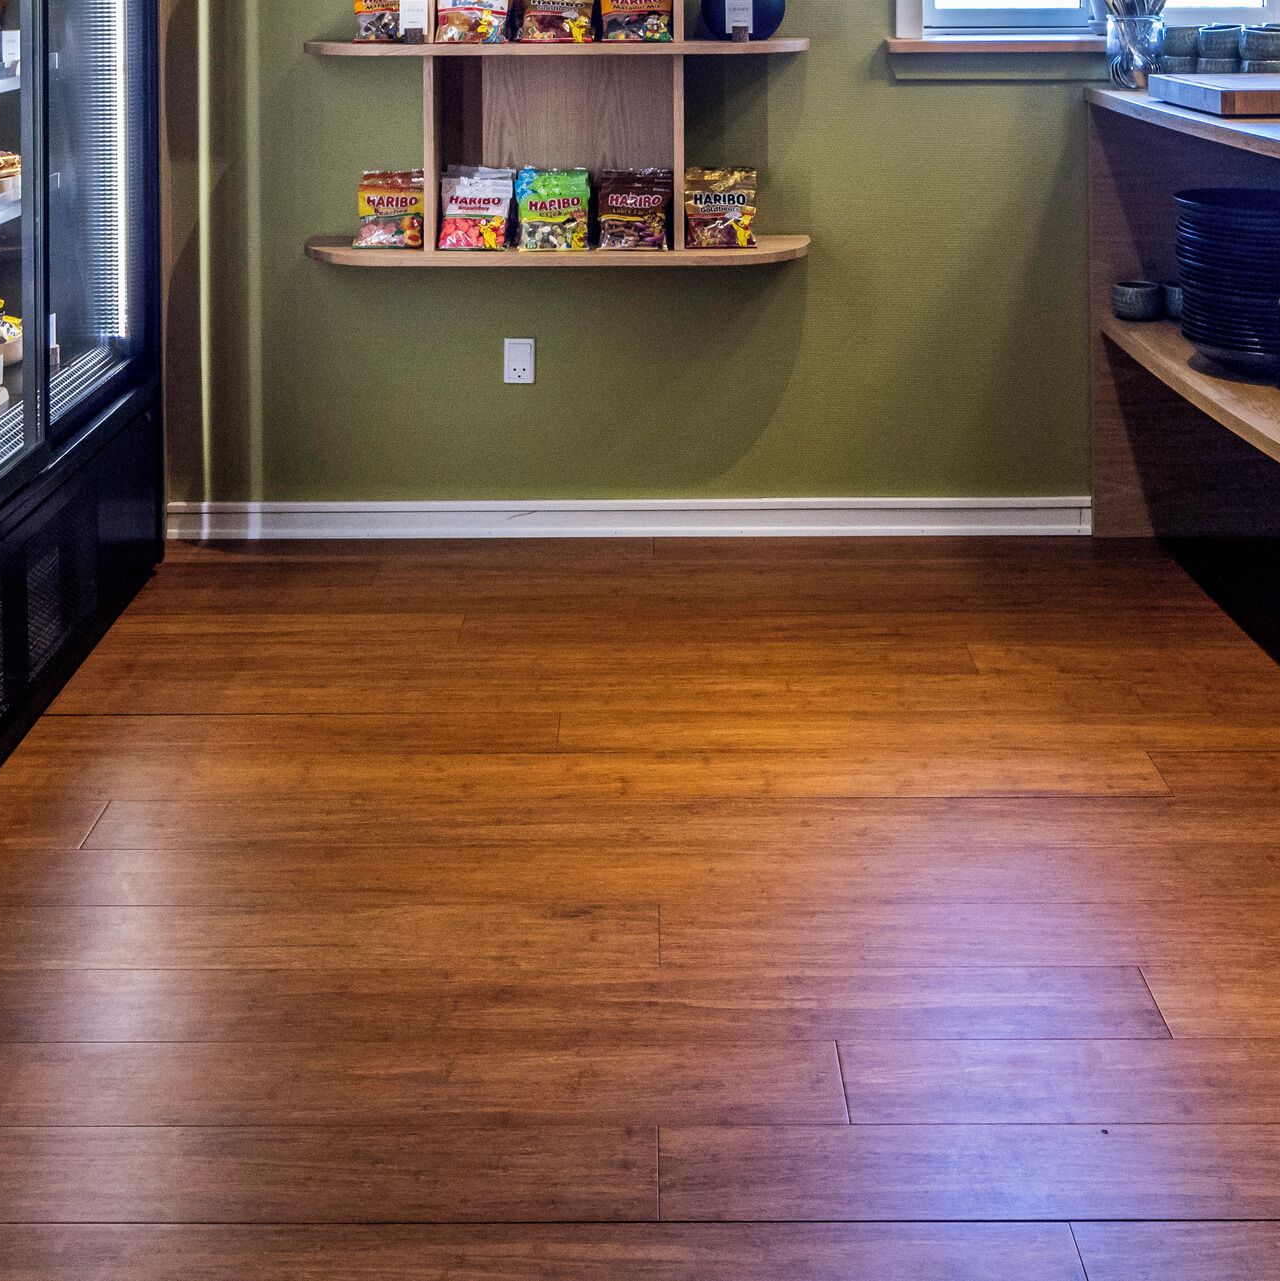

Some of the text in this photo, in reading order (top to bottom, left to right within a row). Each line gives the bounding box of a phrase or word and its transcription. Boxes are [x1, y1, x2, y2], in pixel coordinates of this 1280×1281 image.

[366, 195, 420, 208] HARIBO
[528, 197, 582, 212] HARIBO
[608, 193, 663, 208] HARIBO
[693, 193, 747, 206] HARIBO
